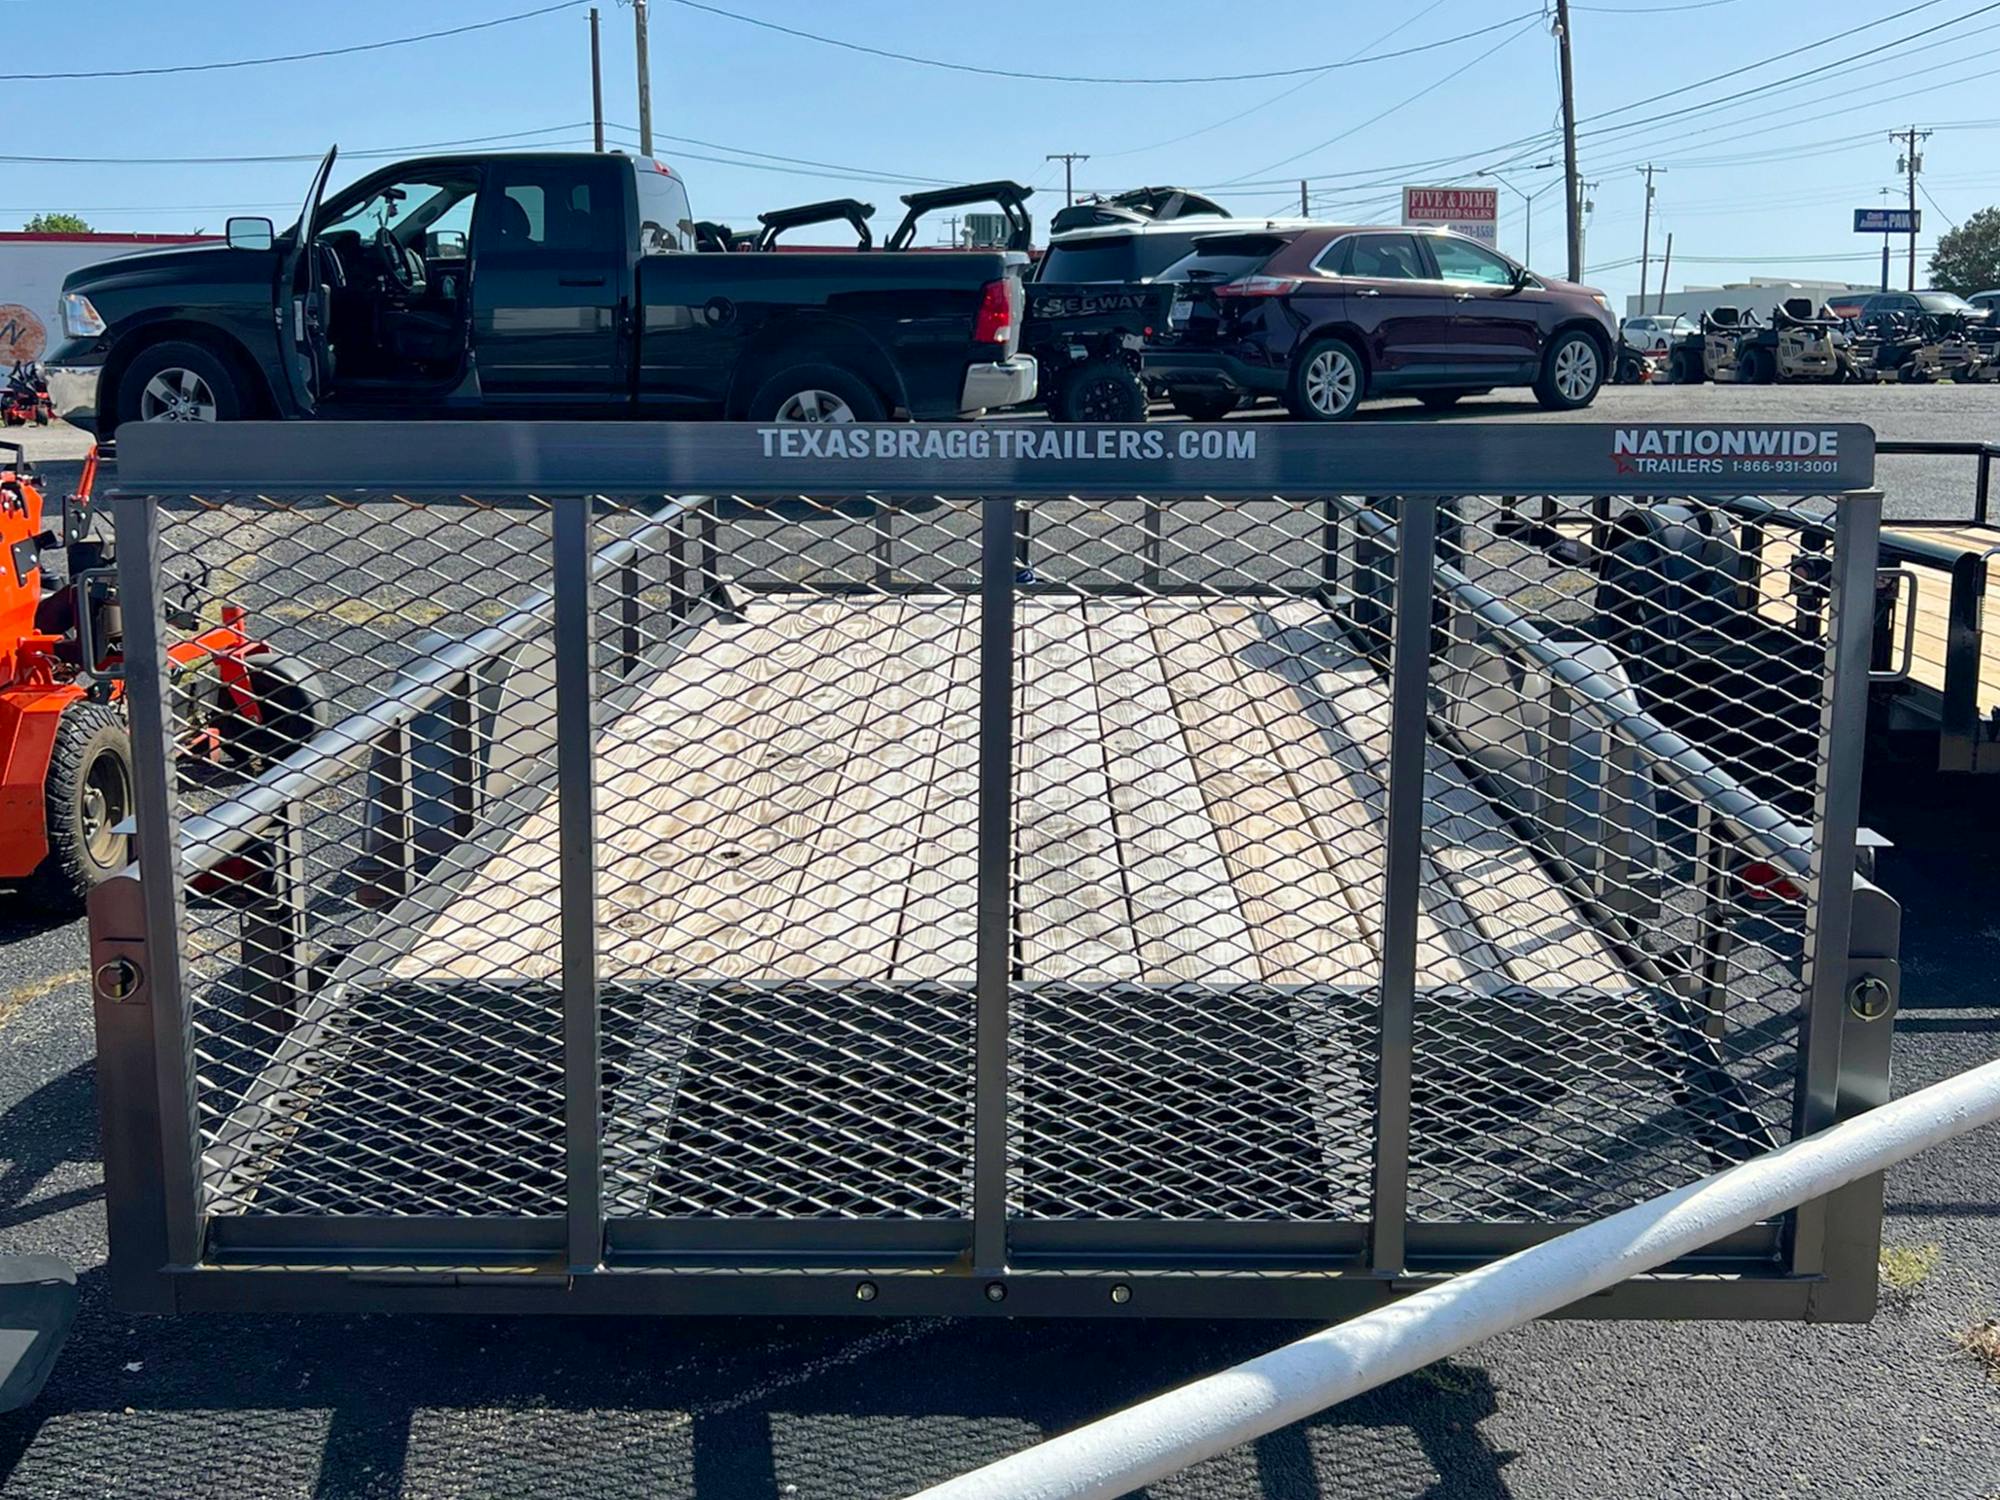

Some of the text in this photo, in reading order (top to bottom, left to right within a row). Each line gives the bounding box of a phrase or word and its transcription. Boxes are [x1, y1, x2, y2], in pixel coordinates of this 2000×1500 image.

[1411, 191, 1494, 208] FIVE & DIME
[1411, 208, 1492, 218] CERTIFIED SALES
[1047, 295, 1146, 312] SEGWAY
[1614, 430, 1838, 456] NATIONWIDE
[1635, 458, 1838, 473] TRAILERS 1-866-931-3001
